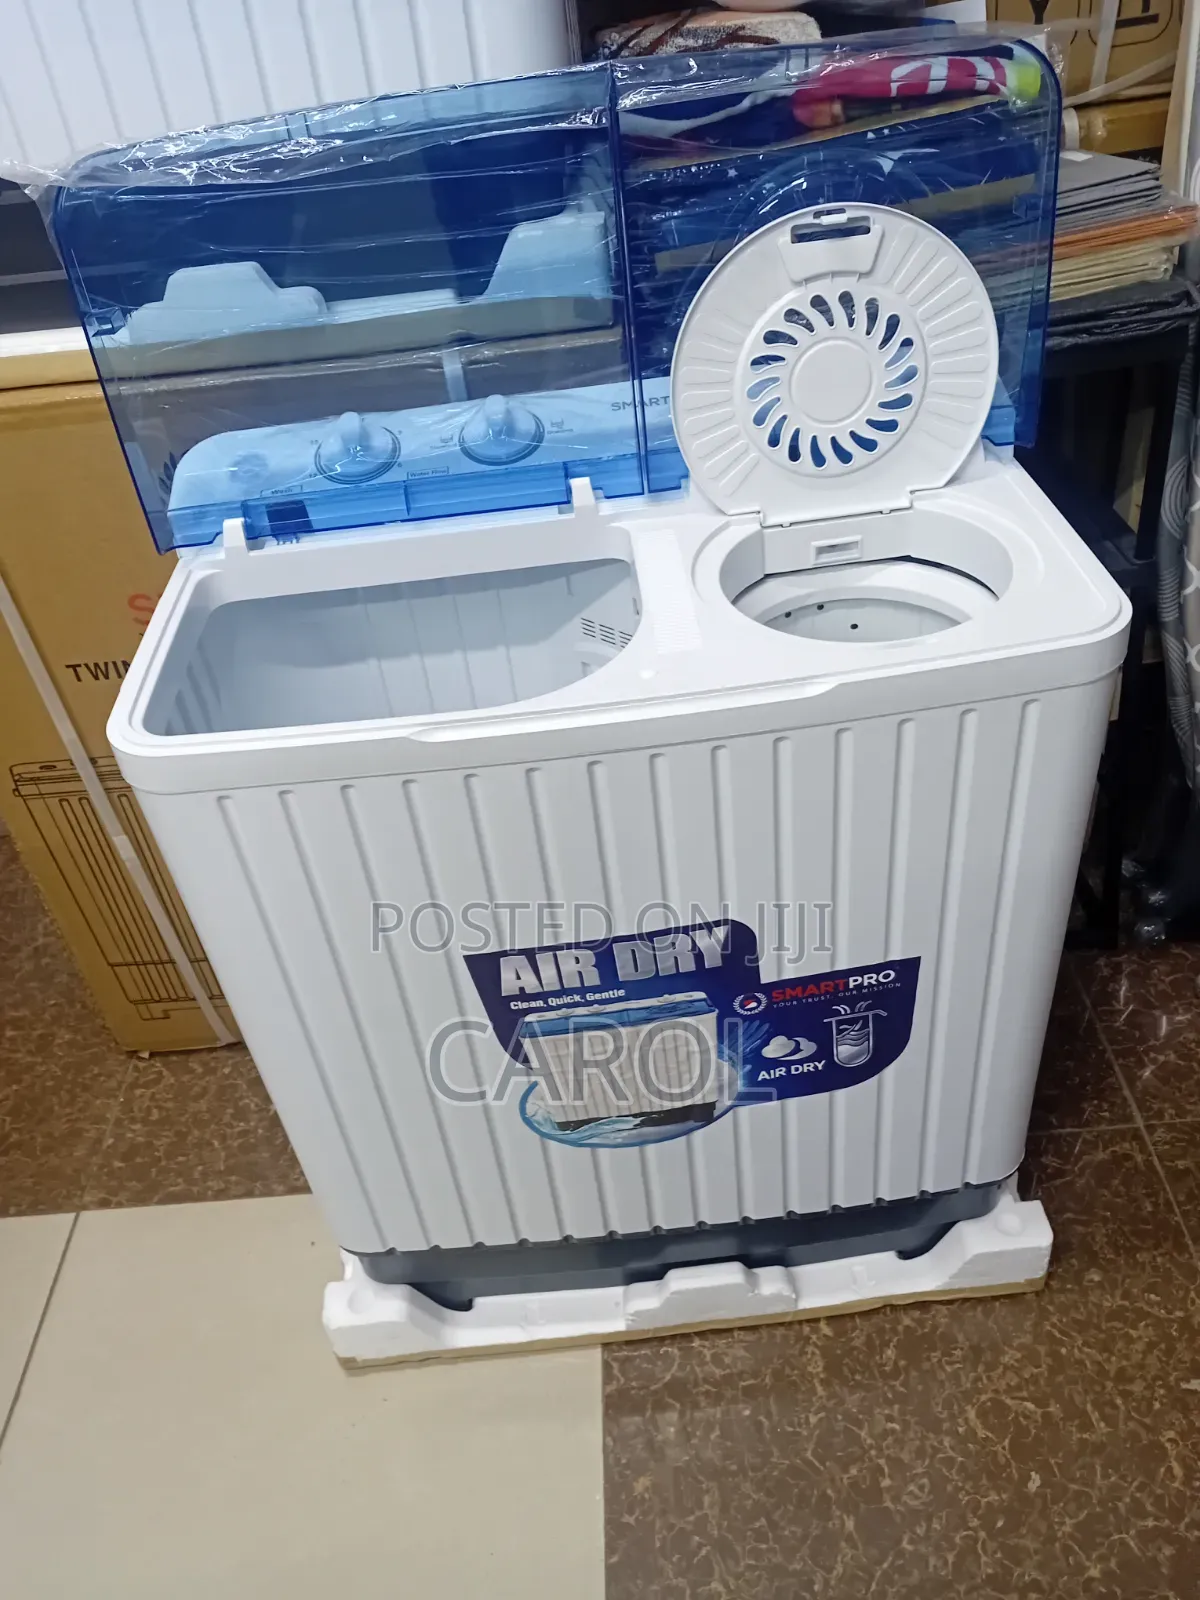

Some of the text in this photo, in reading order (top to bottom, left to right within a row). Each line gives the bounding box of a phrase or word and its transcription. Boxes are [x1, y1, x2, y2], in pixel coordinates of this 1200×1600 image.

[500, 925, 730, 997] AIR DRY
[586, 988, 626, 1001] Gentle
[771, 969, 896, 1002] SMARTPRO
[772, 1000, 798, 1009] YOUR
[837, 990, 857, 998] OUR
[861, 982, 901, 994] MISSION
[757, 1060, 826, 1081] AIR DRY
